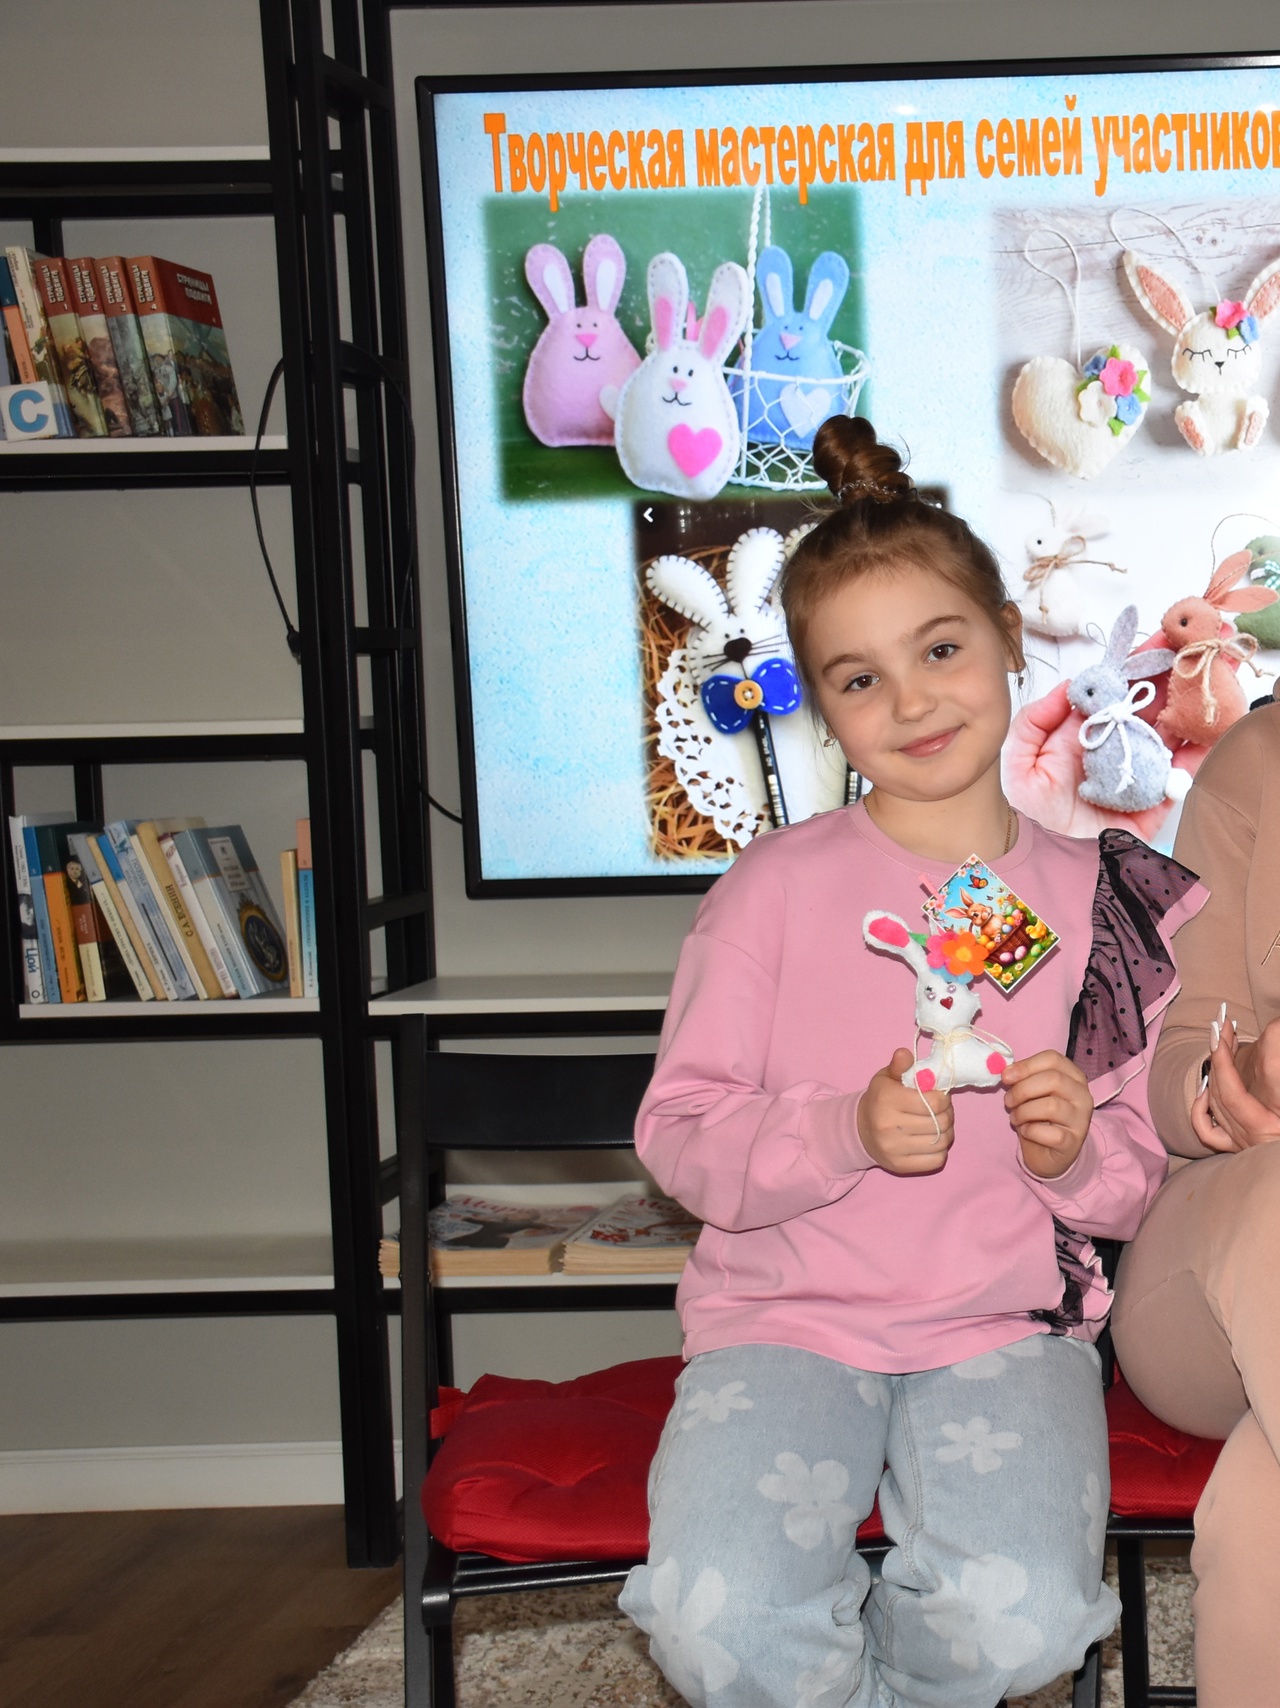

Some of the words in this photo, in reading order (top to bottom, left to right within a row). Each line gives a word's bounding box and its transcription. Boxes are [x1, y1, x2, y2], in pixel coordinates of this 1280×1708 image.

[484, 112, 685, 212] Творческая
[695, 122, 896, 205] мастерская
[905, 120, 965, 196] для
[975, 95, 1083, 177] семей
